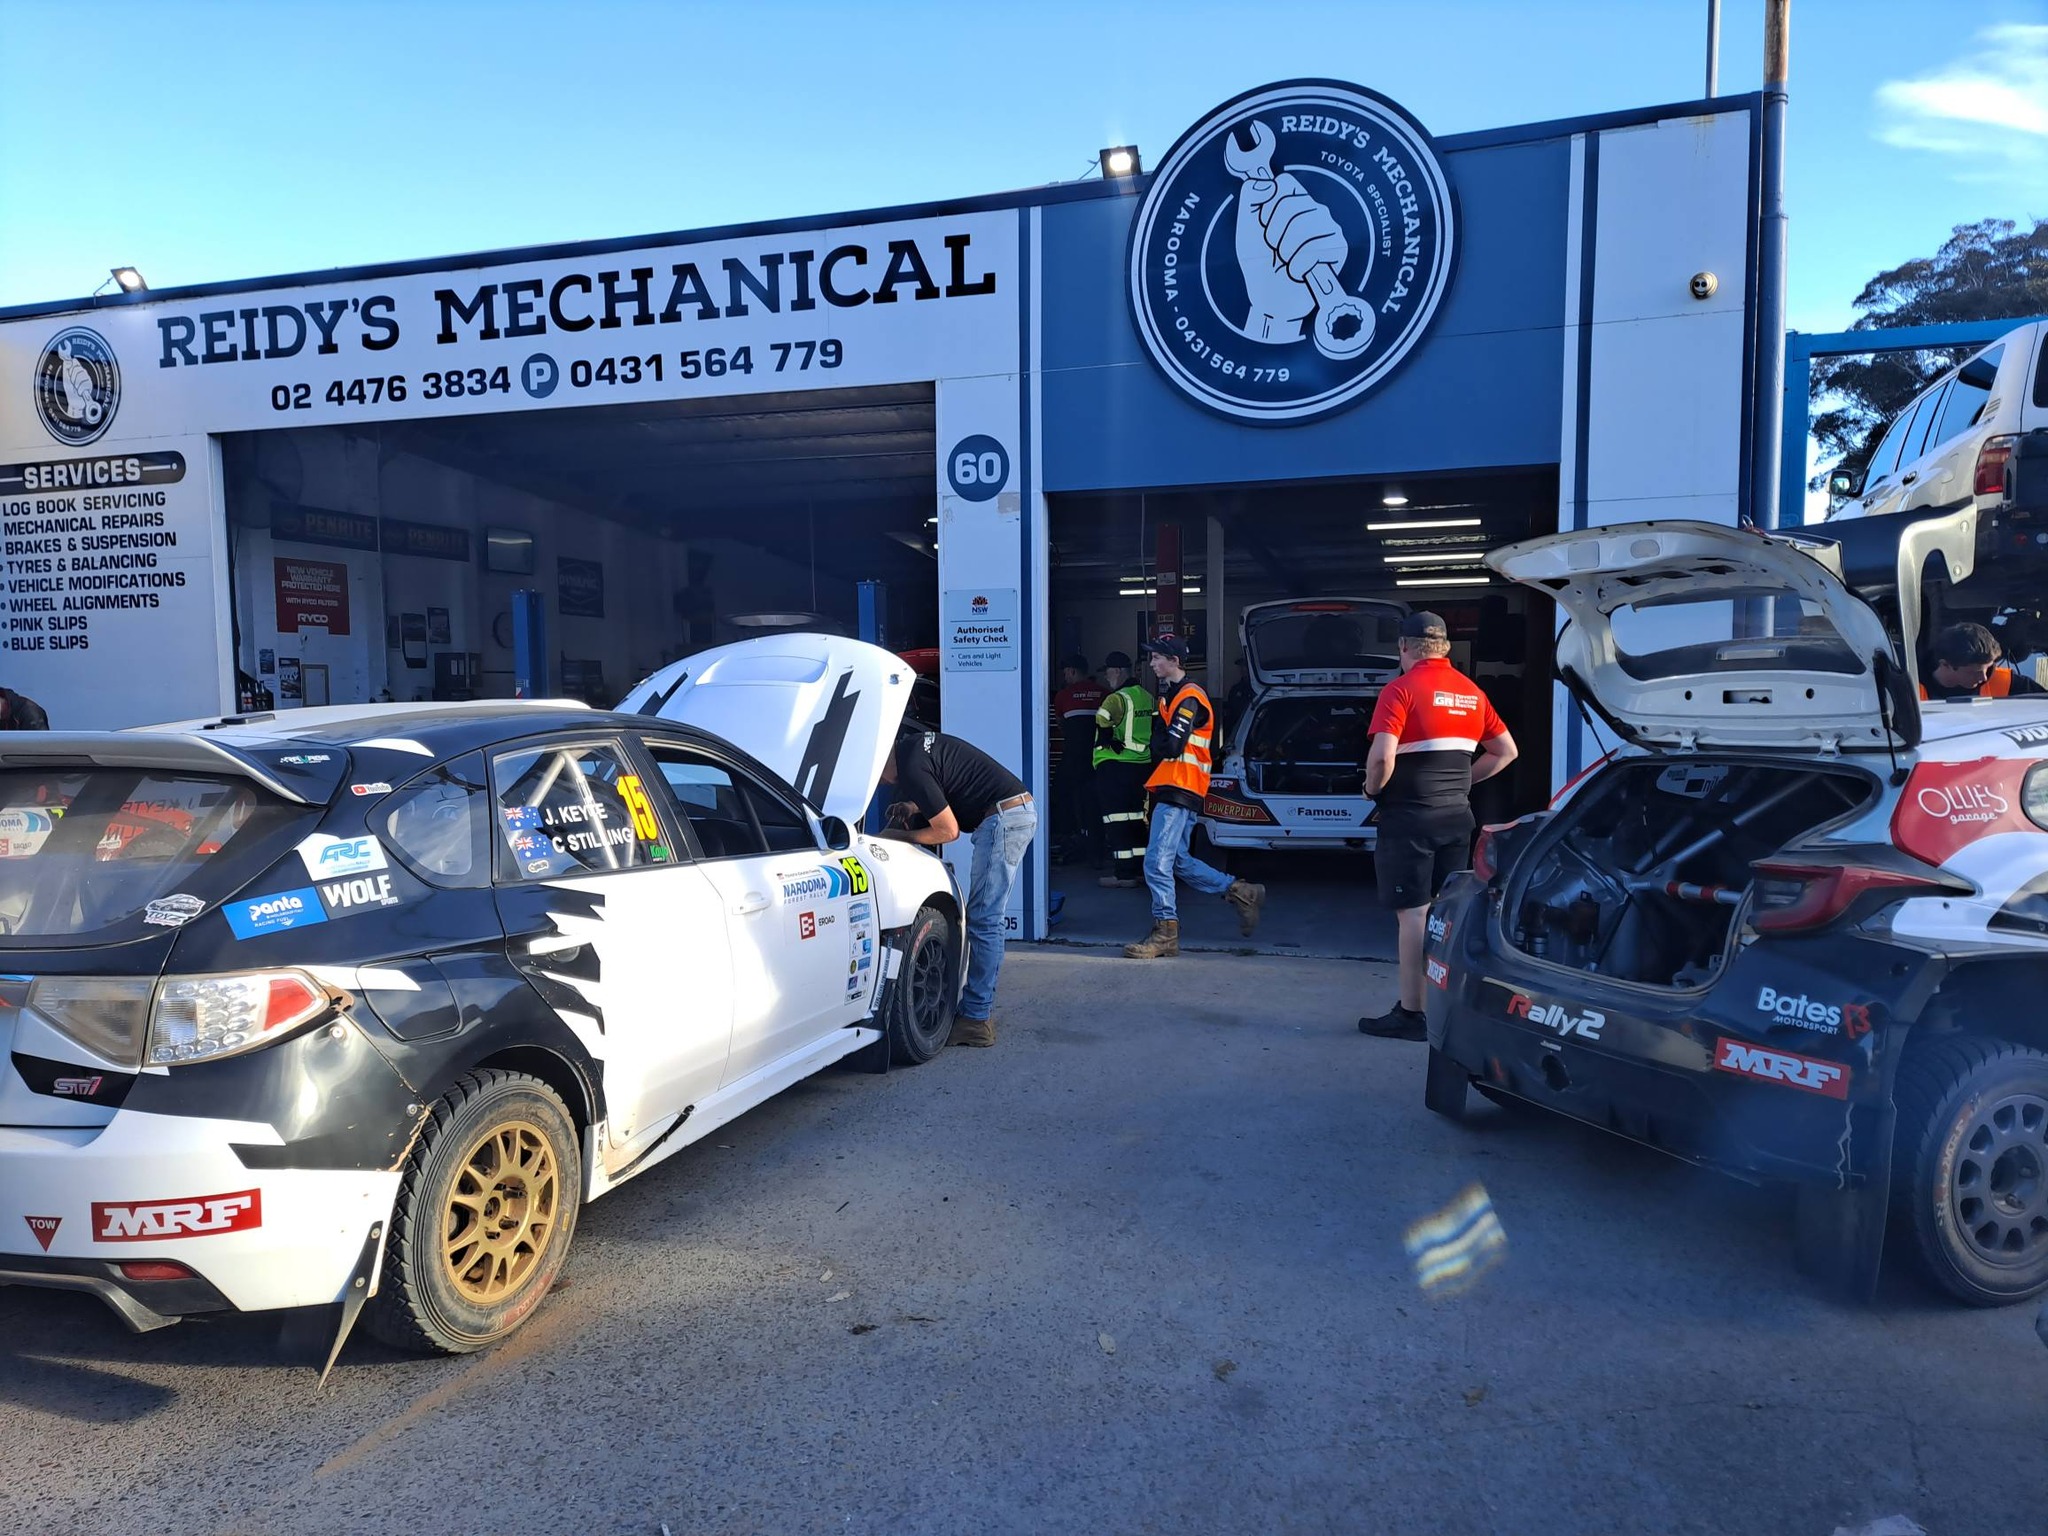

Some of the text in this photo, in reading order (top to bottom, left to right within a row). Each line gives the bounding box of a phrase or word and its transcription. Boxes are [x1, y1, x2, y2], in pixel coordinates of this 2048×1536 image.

[1281, 115, 1422, 315] REIDY'S MECHANICAL
[1320, 151, 1392, 258] TOYOTA SPECIALIST
[1164, 191, 1200, 302] NAROOMA
[157, 233, 996, 369] REIDY'S MECHANICAL
[1175, 316, 1211, 360] 0431
[271, 383, 312, 411] 02
[325, 374, 407, 408] 4476
[422, 366, 511, 400] 3834
[570, 353, 664, 388] 0431
[680, 345, 754, 379] 564
[770, 338, 844, 373] 779
[1210, 354, 1246, 380] 564
[1253, 368, 1290, 383] 779
[24, 458, 141, 489] SERVICES
[955, 451, 1002, 485] 60
[3, 491, 166, 516] LOG BOOK SERVICING
[4, 512, 164, 536] MECHANICAL REPAIRS
[5, 532, 177, 555] BRAKES & SUSPENSION
[7, 553, 157, 574] TYRES & BALANCING
[8, 572, 186, 593] VEHICLE MODIFICATIONS
[9, 593, 160, 612] WHEEL ALIGNMENTS
[10, 616, 88, 632] PINK SLIPS
[297, 613, 329, 624] RYCO
[957, 625, 1004, 634] Authorised
[11, 635, 89, 650] BLUE SLIPS
[953, 635, 1009, 645] Safety Check
[986, 652, 1001, 660] Light
[367, 784, 390, 792] YouTube
[545, 811, 558, 825] J.
[616, 775, 658, 841] 15
[1208, 802, 1258, 818] POWERPLAY
[1297, 807, 1352, 817] Famous.
[1950, 812, 1998, 824] garage
[320, 840, 370, 864] ARC
[842, 856, 868, 893] 15
[323, 874, 391, 908] WOLF
[783, 877, 827, 898] NAROOMA
[249, 896, 302, 921] panta
[254, 919, 275, 928] RACING
[818, 915, 835, 926] EROAD
[1507, 994, 1606, 1040] Rally2
[1757, 986, 1842, 1026] Bates
[1773, 1015, 1838, 1035] MOTORSPORT
[1721, 1043, 1841, 1089] MRF
[31, 1219, 56, 1230] TOW
[102, 1196, 252, 1236] MRF
